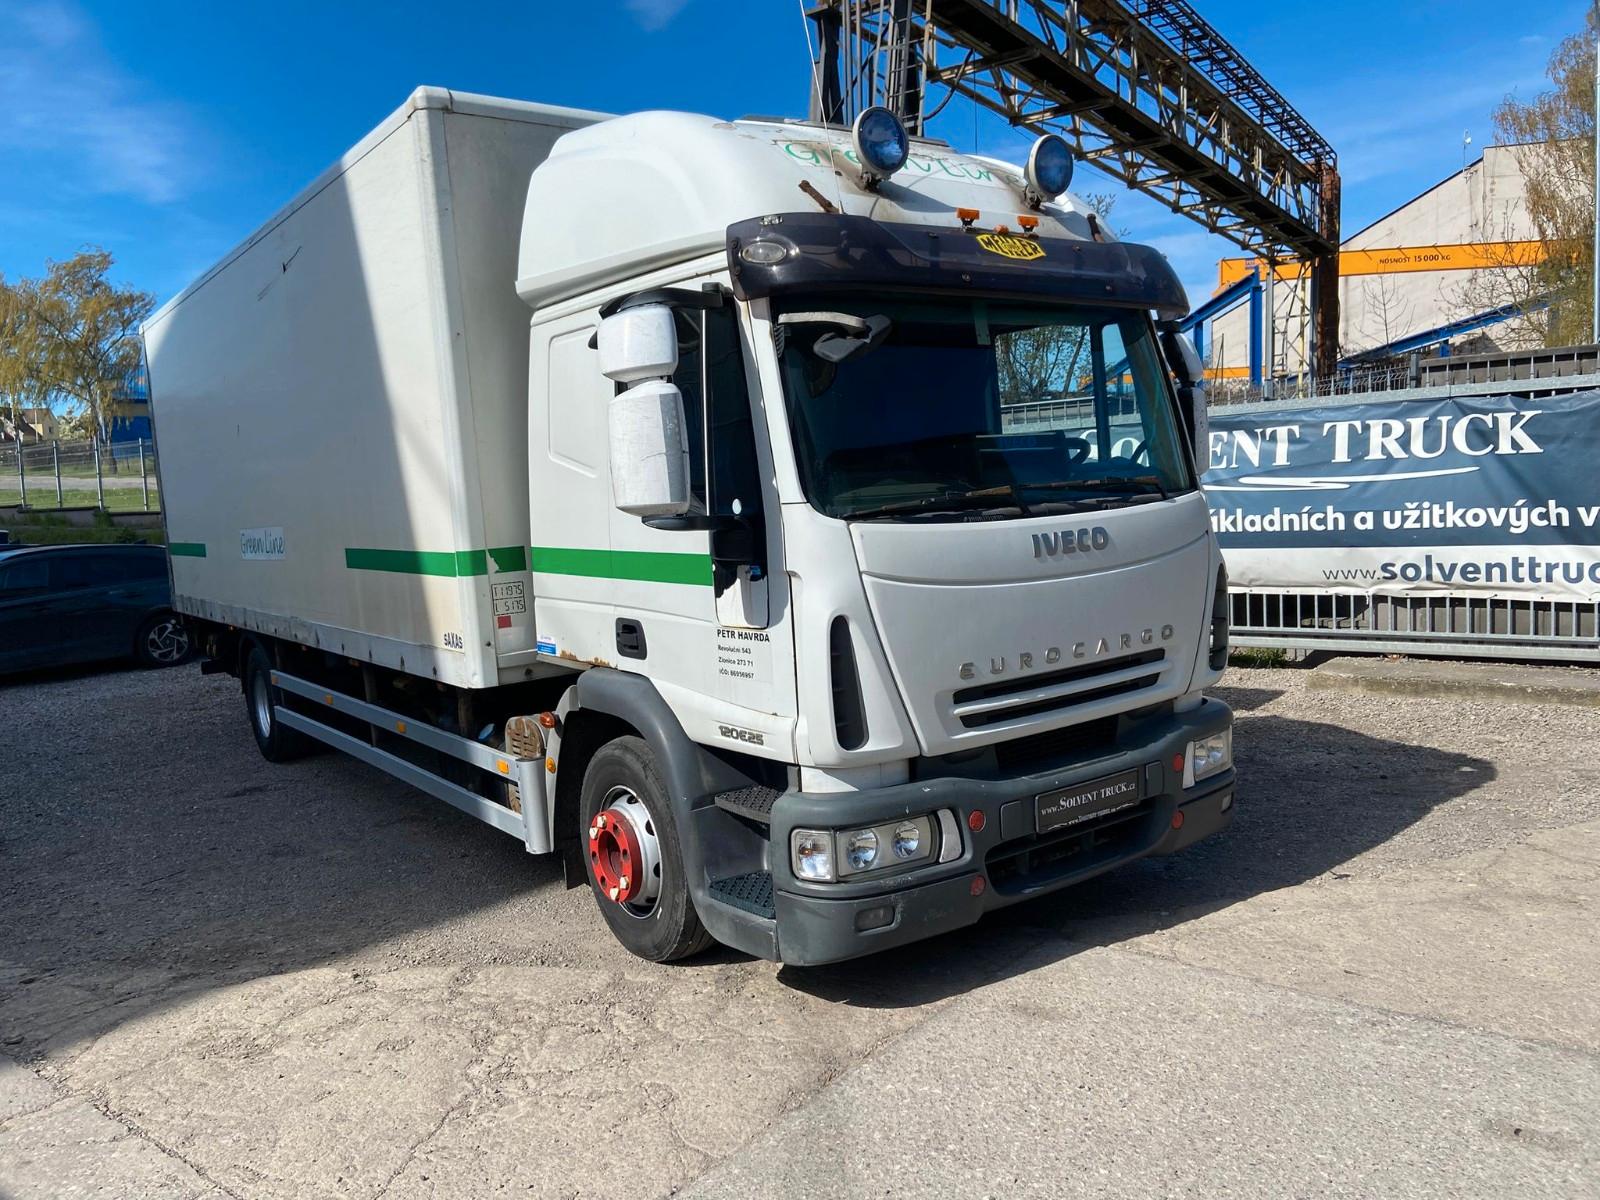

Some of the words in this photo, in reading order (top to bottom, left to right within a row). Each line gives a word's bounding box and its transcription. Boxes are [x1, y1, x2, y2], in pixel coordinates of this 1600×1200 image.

[784, 142, 931, 173] Gren
[1379, 256, 1411, 265] NOSNOST
[1322, 409, 1544, 464] TRUCK
[1210, 505, 1346, 533] kladních
[1353, 511, 1374, 531] a
[1383, 499, 1570, 534] užitkových
[241, 532, 264, 556] Green
[264, 530, 284, 555] Line
[1032, 526, 1109, 559] IVECO
[443, 632, 463, 649] SAXAS
[717, 629, 736, 640] PETR
[737, 631, 770, 643] HAVRDA
[958, 624, 1176, 680] EUROCARGO
[718, 724, 764, 746] 120E25
